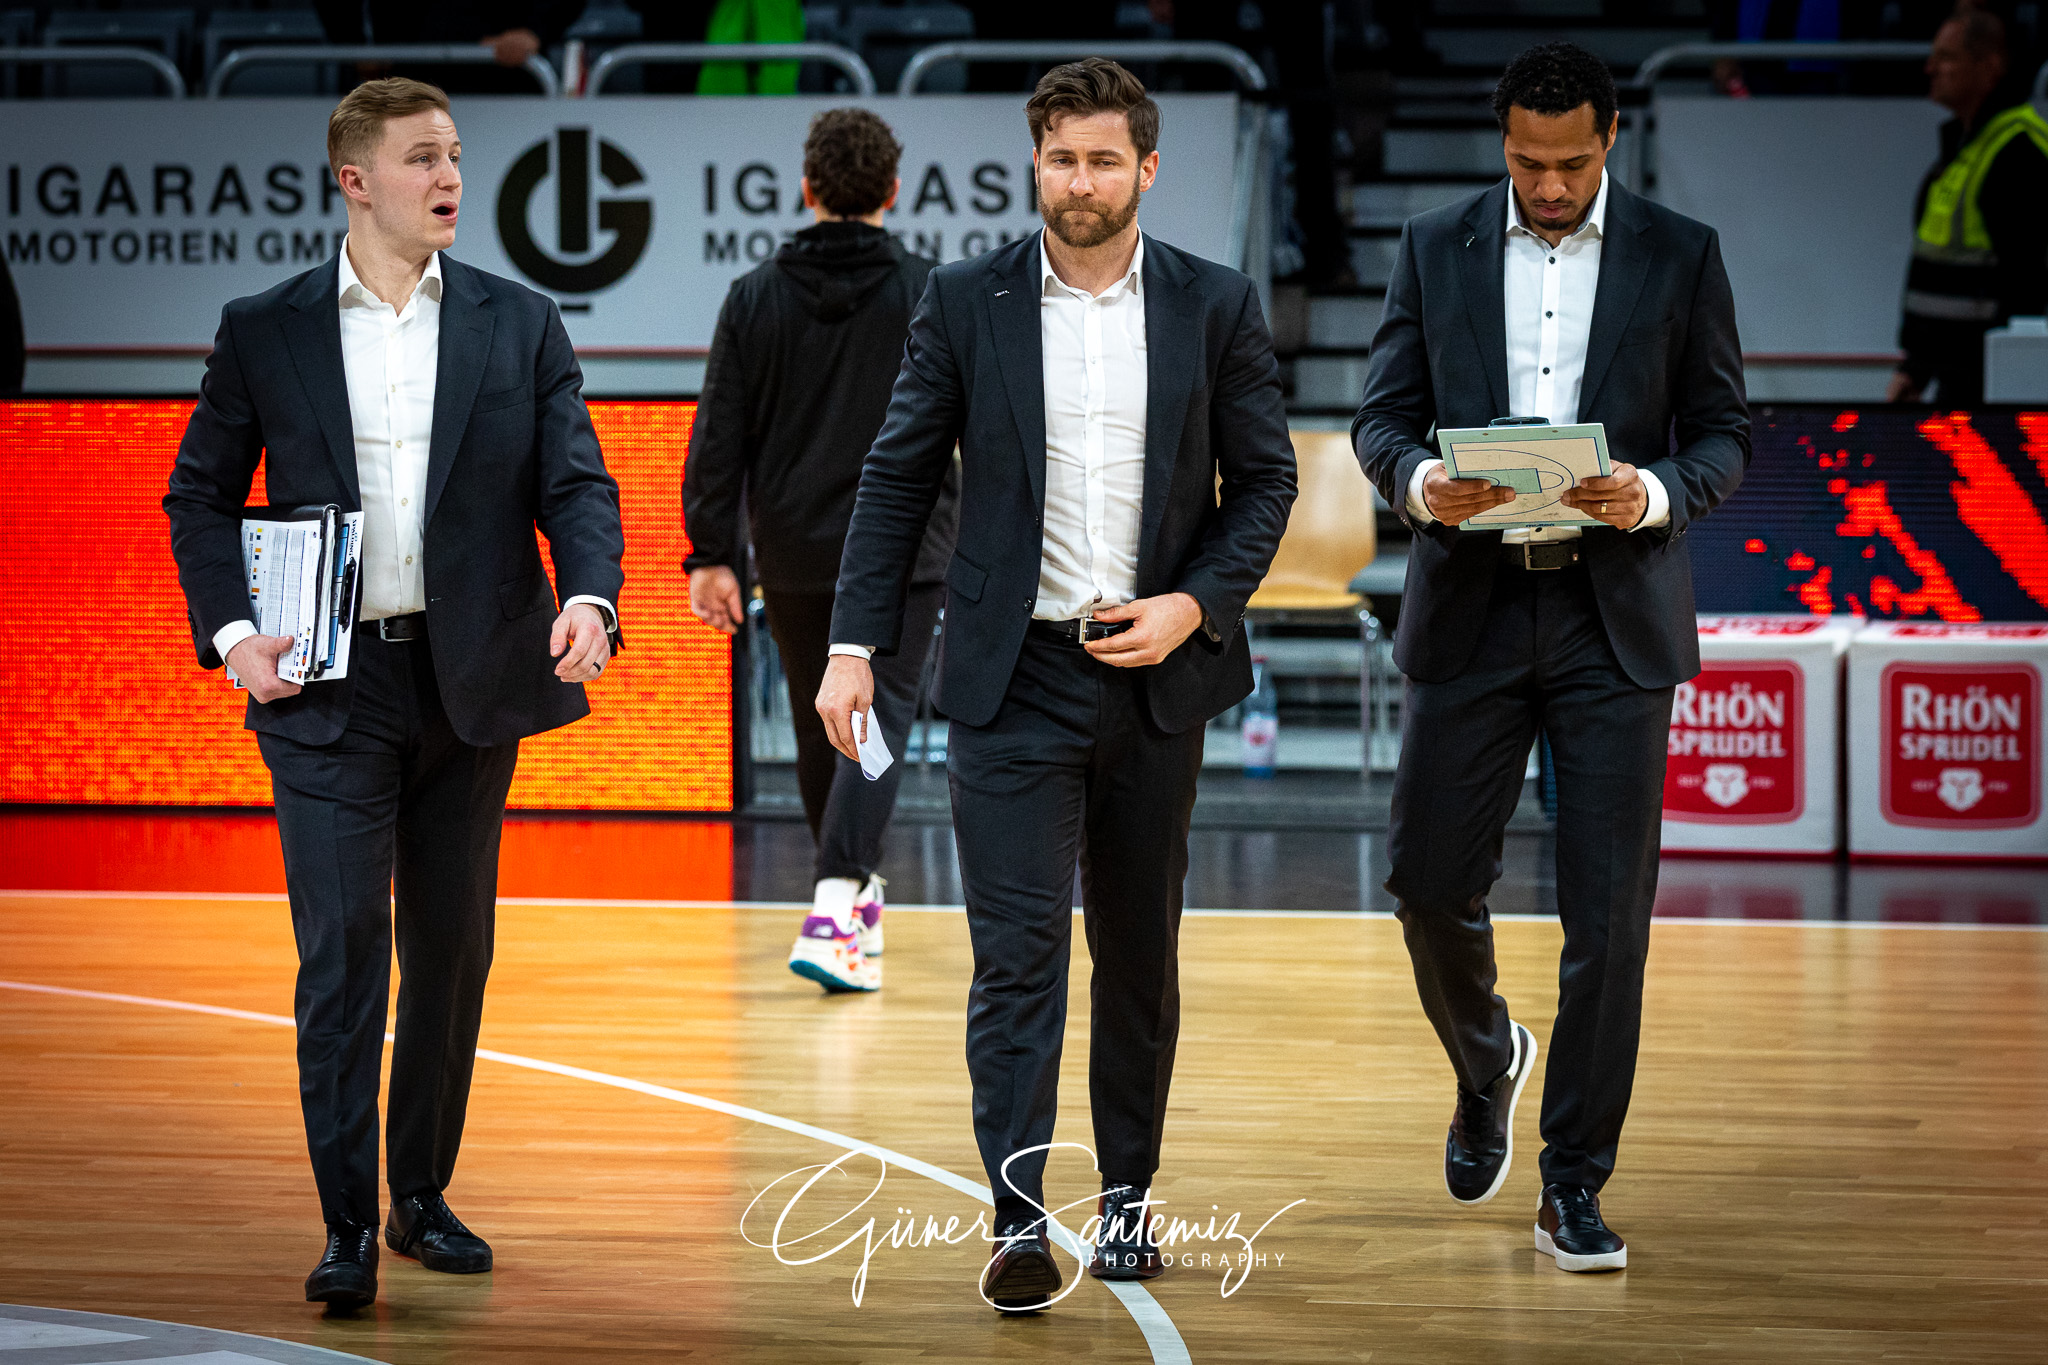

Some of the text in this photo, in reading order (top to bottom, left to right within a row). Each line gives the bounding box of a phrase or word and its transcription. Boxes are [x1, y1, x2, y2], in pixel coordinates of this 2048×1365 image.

[9, 230, 238, 264] MOTOREN
[1901, 683, 2021, 731] RHÖN
[1668, 728, 1787, 758] SPRUDEL
[1900, 732, 2022, 761] SPRUDEL
